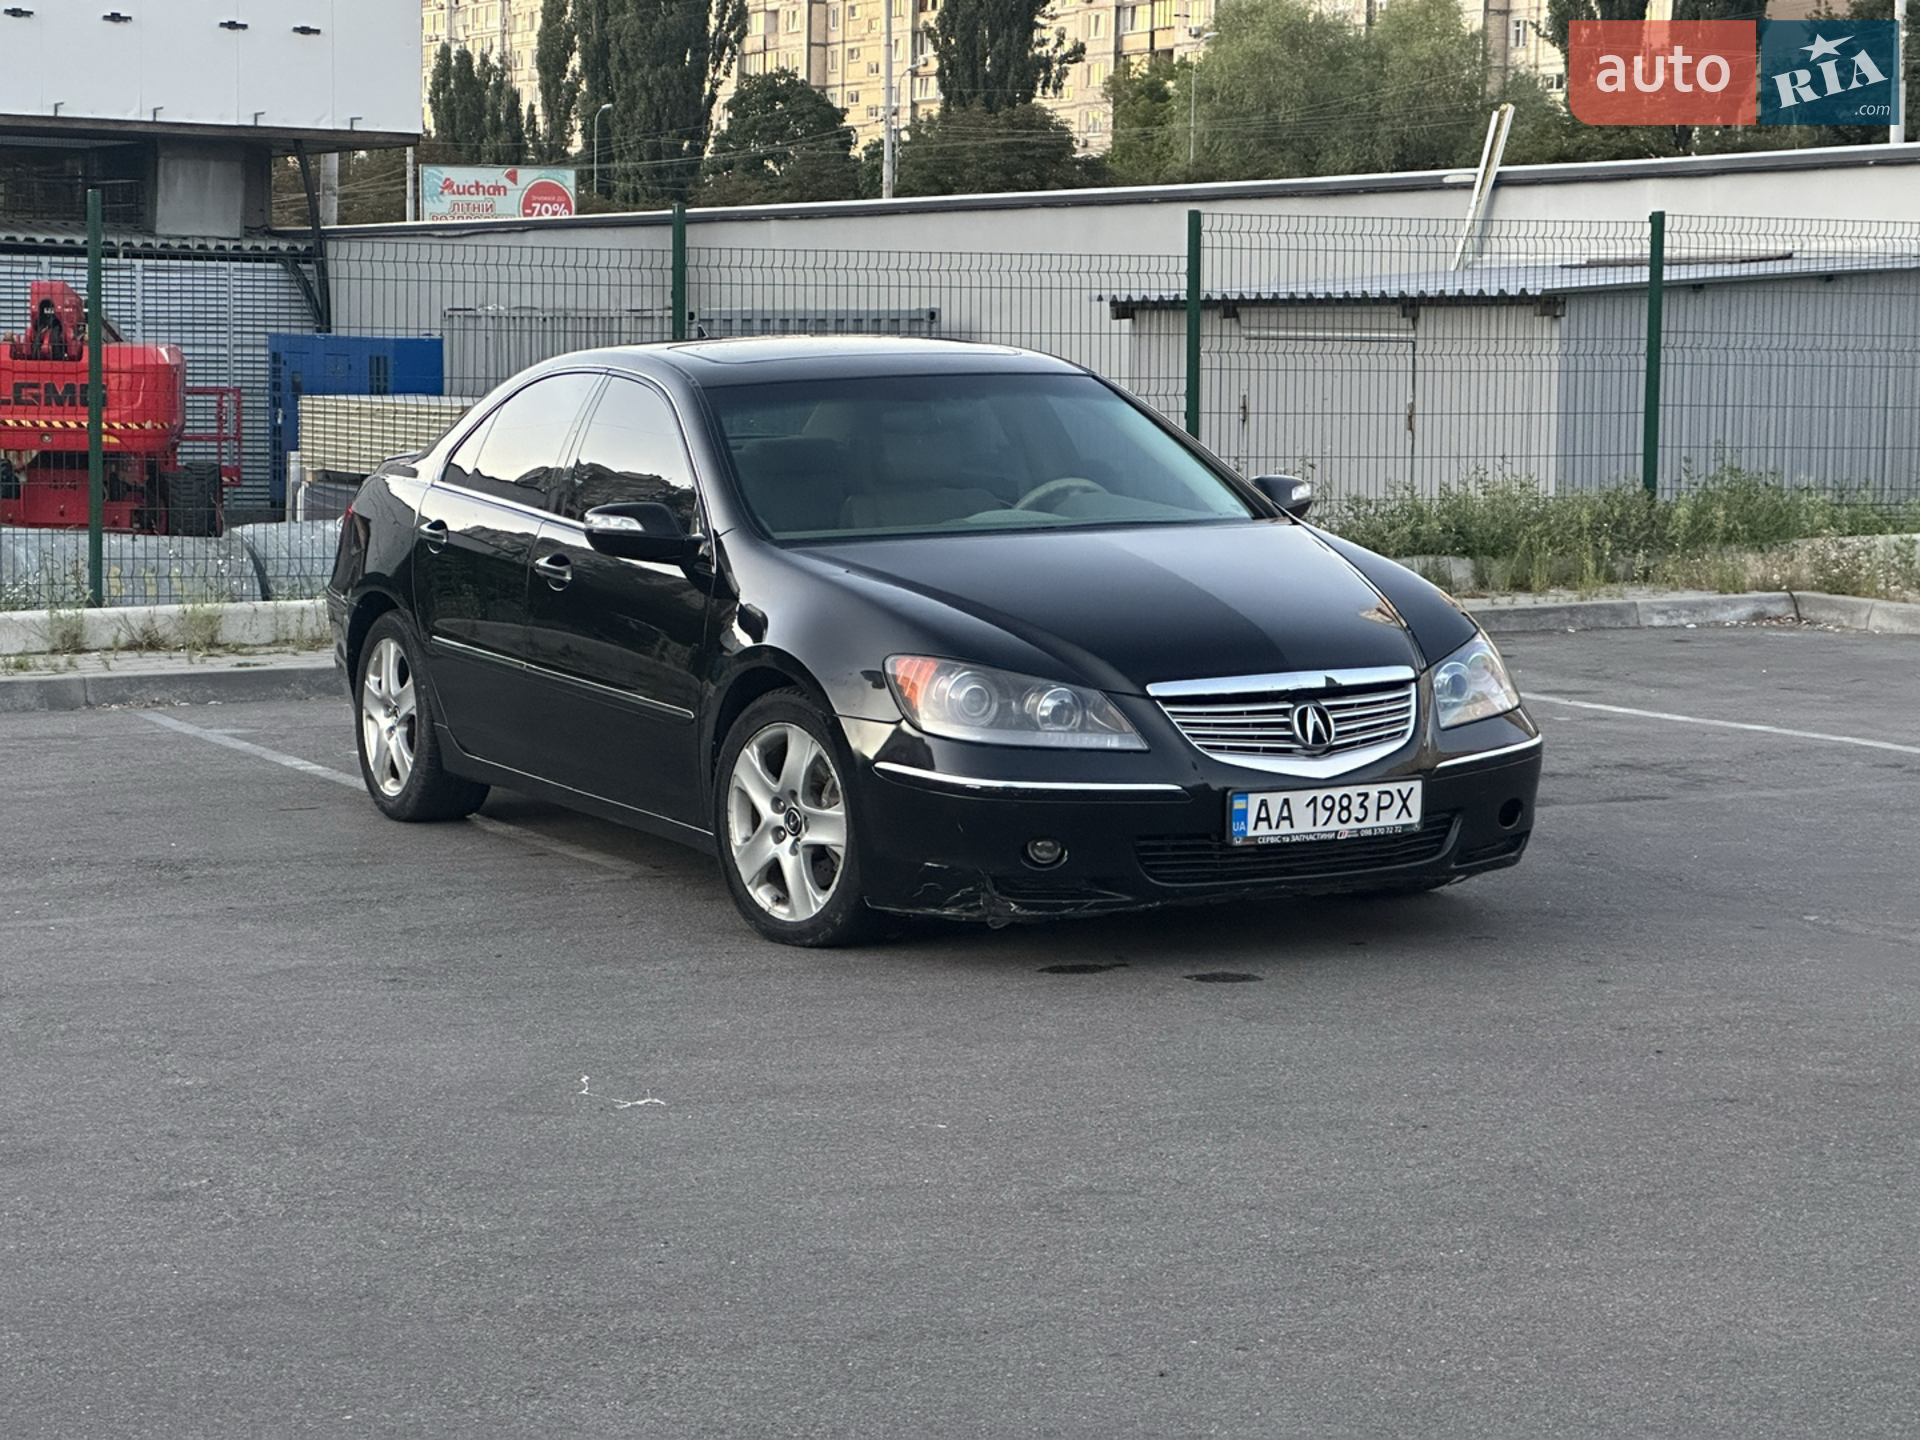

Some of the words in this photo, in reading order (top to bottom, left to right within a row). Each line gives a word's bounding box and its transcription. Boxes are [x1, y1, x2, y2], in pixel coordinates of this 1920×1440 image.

[439, 177, 507, 196] Auchan
[450, 199, 494, 213] ЛІТНІЙ
[524, 203, 569, 217] -70%
[1253, 798, 1294, 831] AA
[1305, 791, 1369, 827] 1983
[1375, 787, 1414, 822] PX
[1232, 821, 1246, 832] UA
[1258, 836, 1282, 844] СЕРВІС
